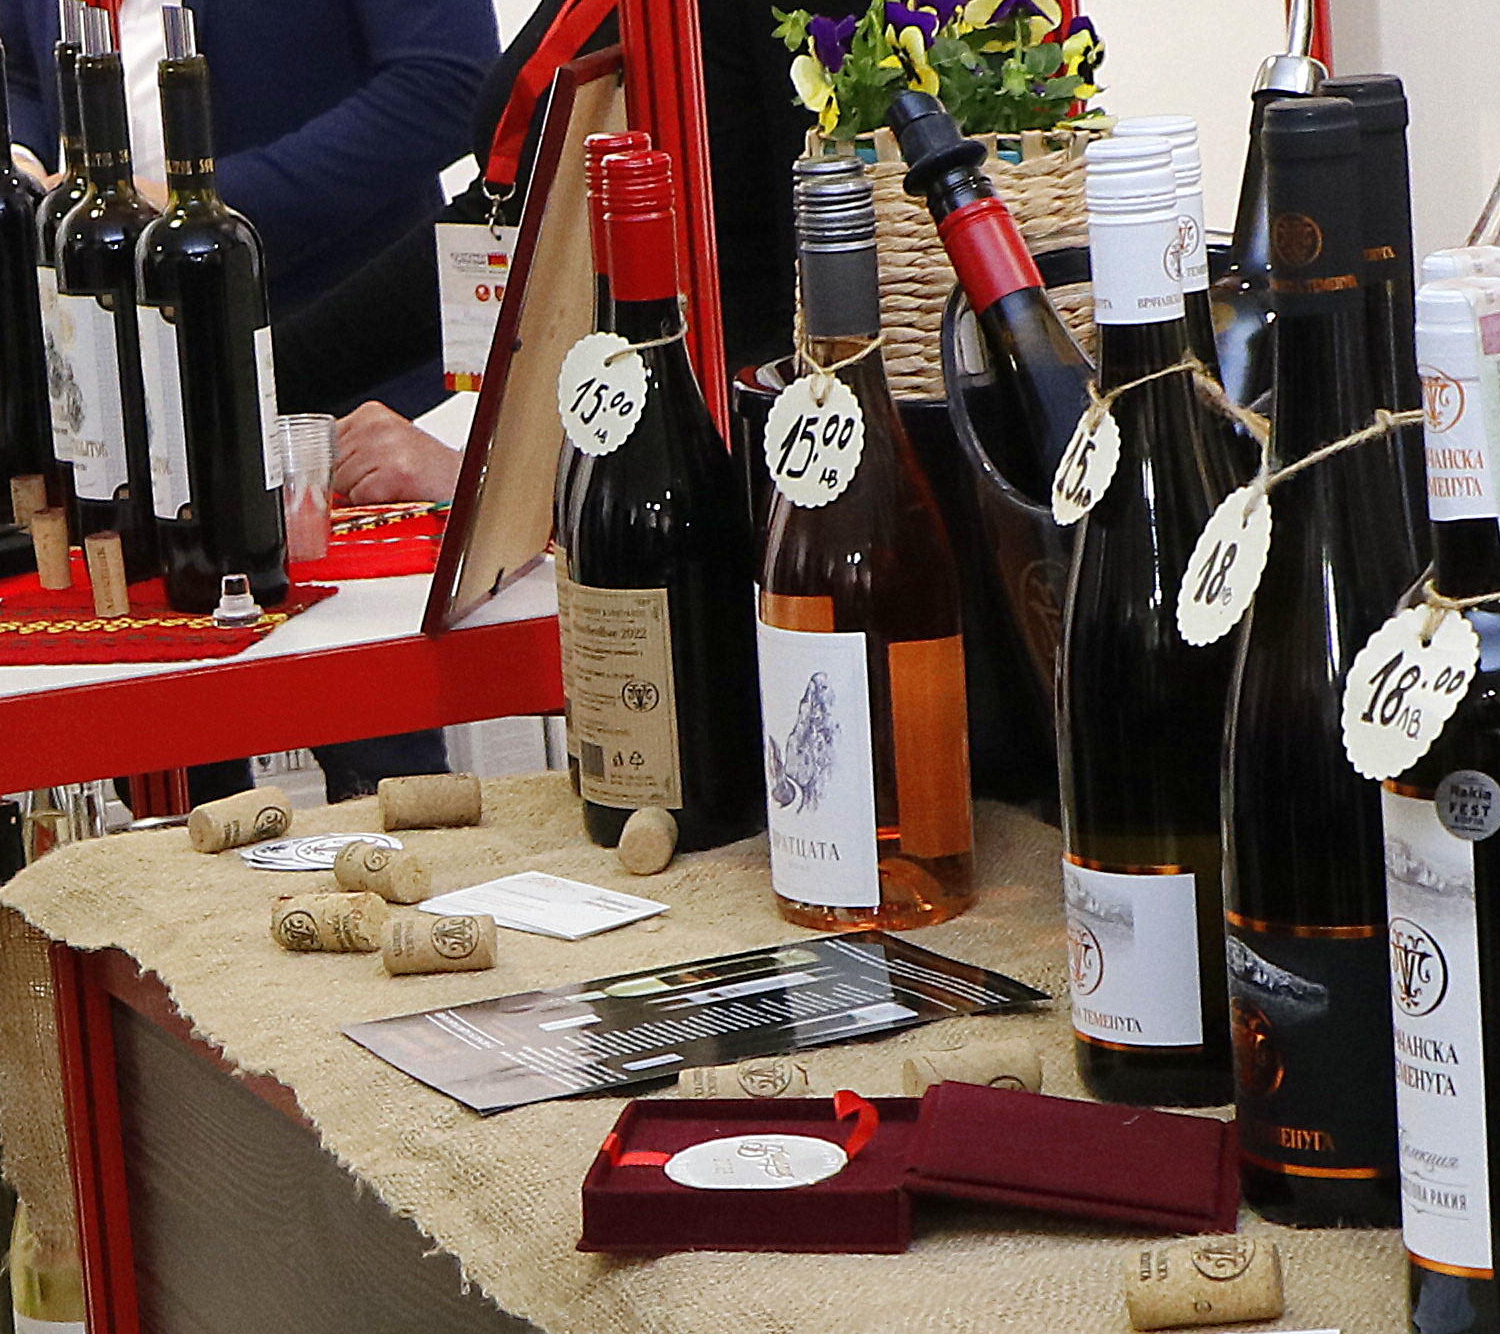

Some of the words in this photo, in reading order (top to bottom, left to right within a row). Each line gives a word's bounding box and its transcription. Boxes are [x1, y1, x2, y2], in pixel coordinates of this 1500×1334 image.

[570, 377, 634, 425] 15.00
[1057, 432, 1096, 500] 15
[1193, 540, 1238, 605] 18
[1361, 651, 1466, 726] 18.00
[1449, 802, 1492, 817] FEST
